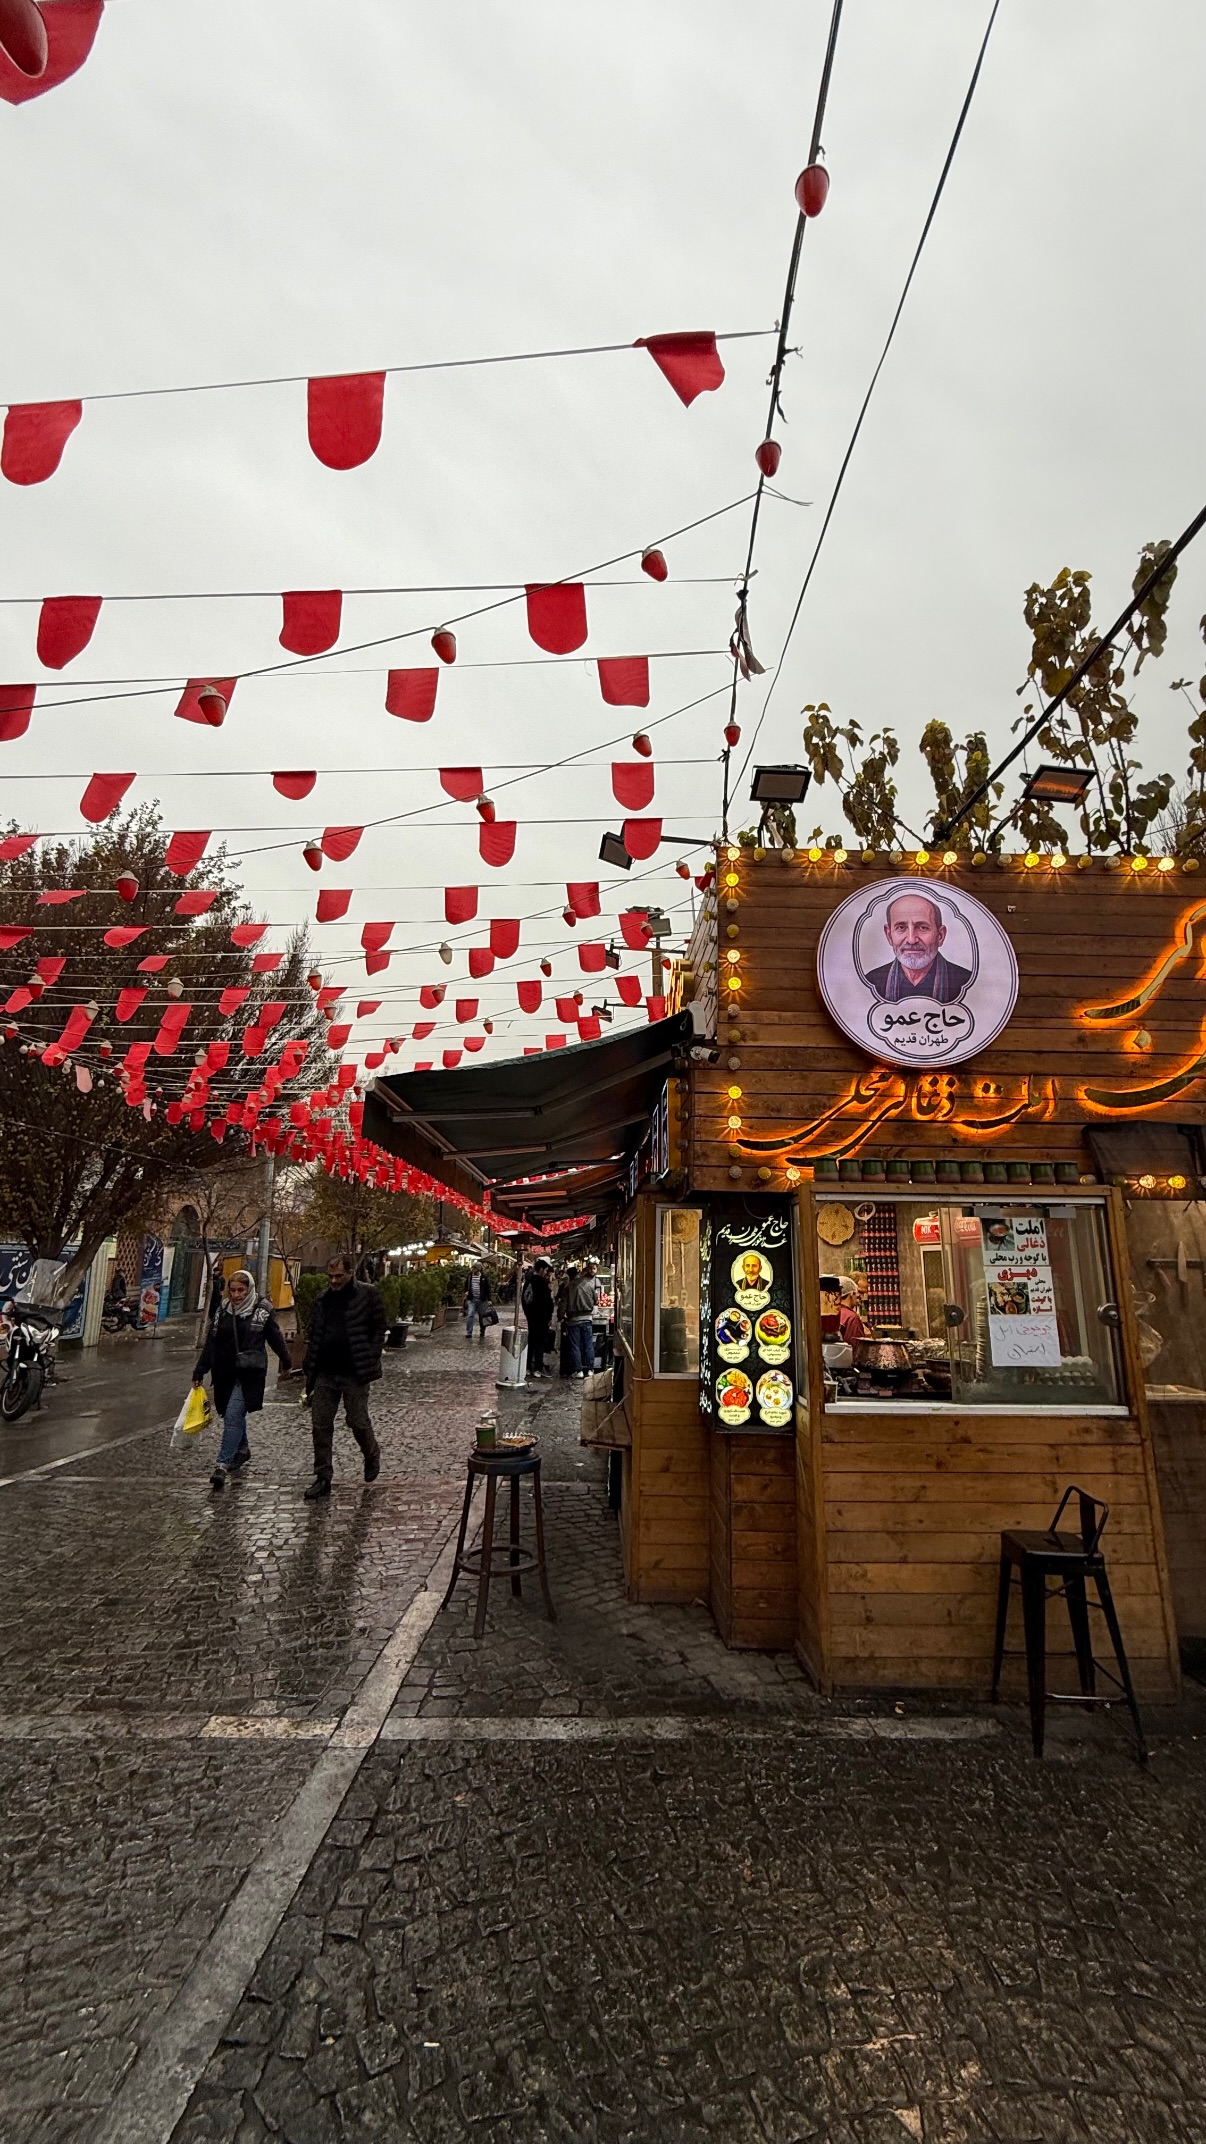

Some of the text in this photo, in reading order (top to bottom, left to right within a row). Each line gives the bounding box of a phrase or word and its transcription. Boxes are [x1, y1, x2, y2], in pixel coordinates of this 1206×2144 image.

[880, 1008, 966, 1034] حاج عمو
[894, 1032, 949, 1047] طهران قدیم
[957, 1073, 1057, 1130] املت
[761, 1215, 789, 1237] حاج عمو
[1016, 1236, 1046, 1252] ذغالی
[989, 1252, 1047, 1264] با گوجه و رب محلی
[1034, 1278, 1046, 1286] محلی
[740, 1293, 767, 1303] حاج عمو
